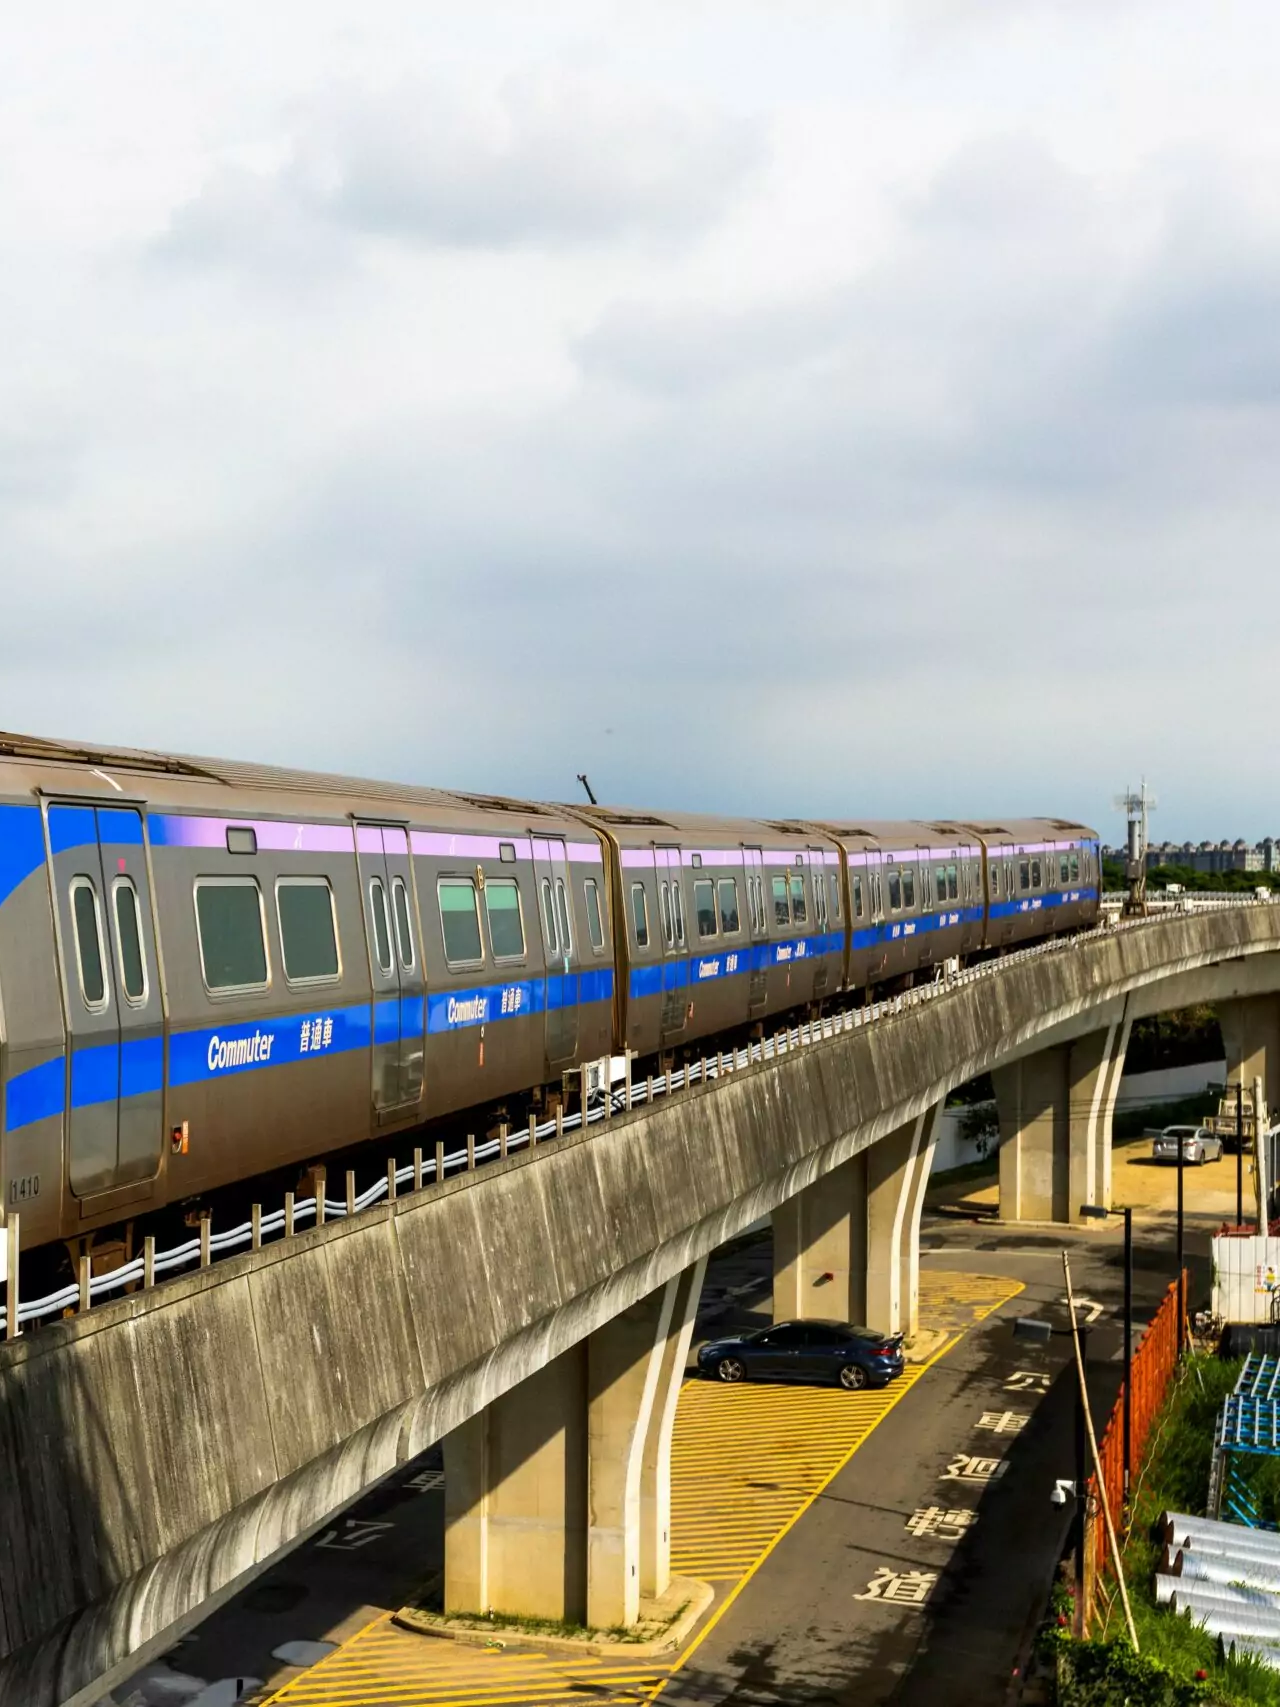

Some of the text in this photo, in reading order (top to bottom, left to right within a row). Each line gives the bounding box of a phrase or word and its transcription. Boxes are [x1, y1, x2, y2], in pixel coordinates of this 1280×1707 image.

[448, 995, 487, 1023] Commuter
[208, 1030, 274, 1070] Commuter
[300, 1017, 333, 1053] 普通車
[13, 1175, 39, 1200] 1410
